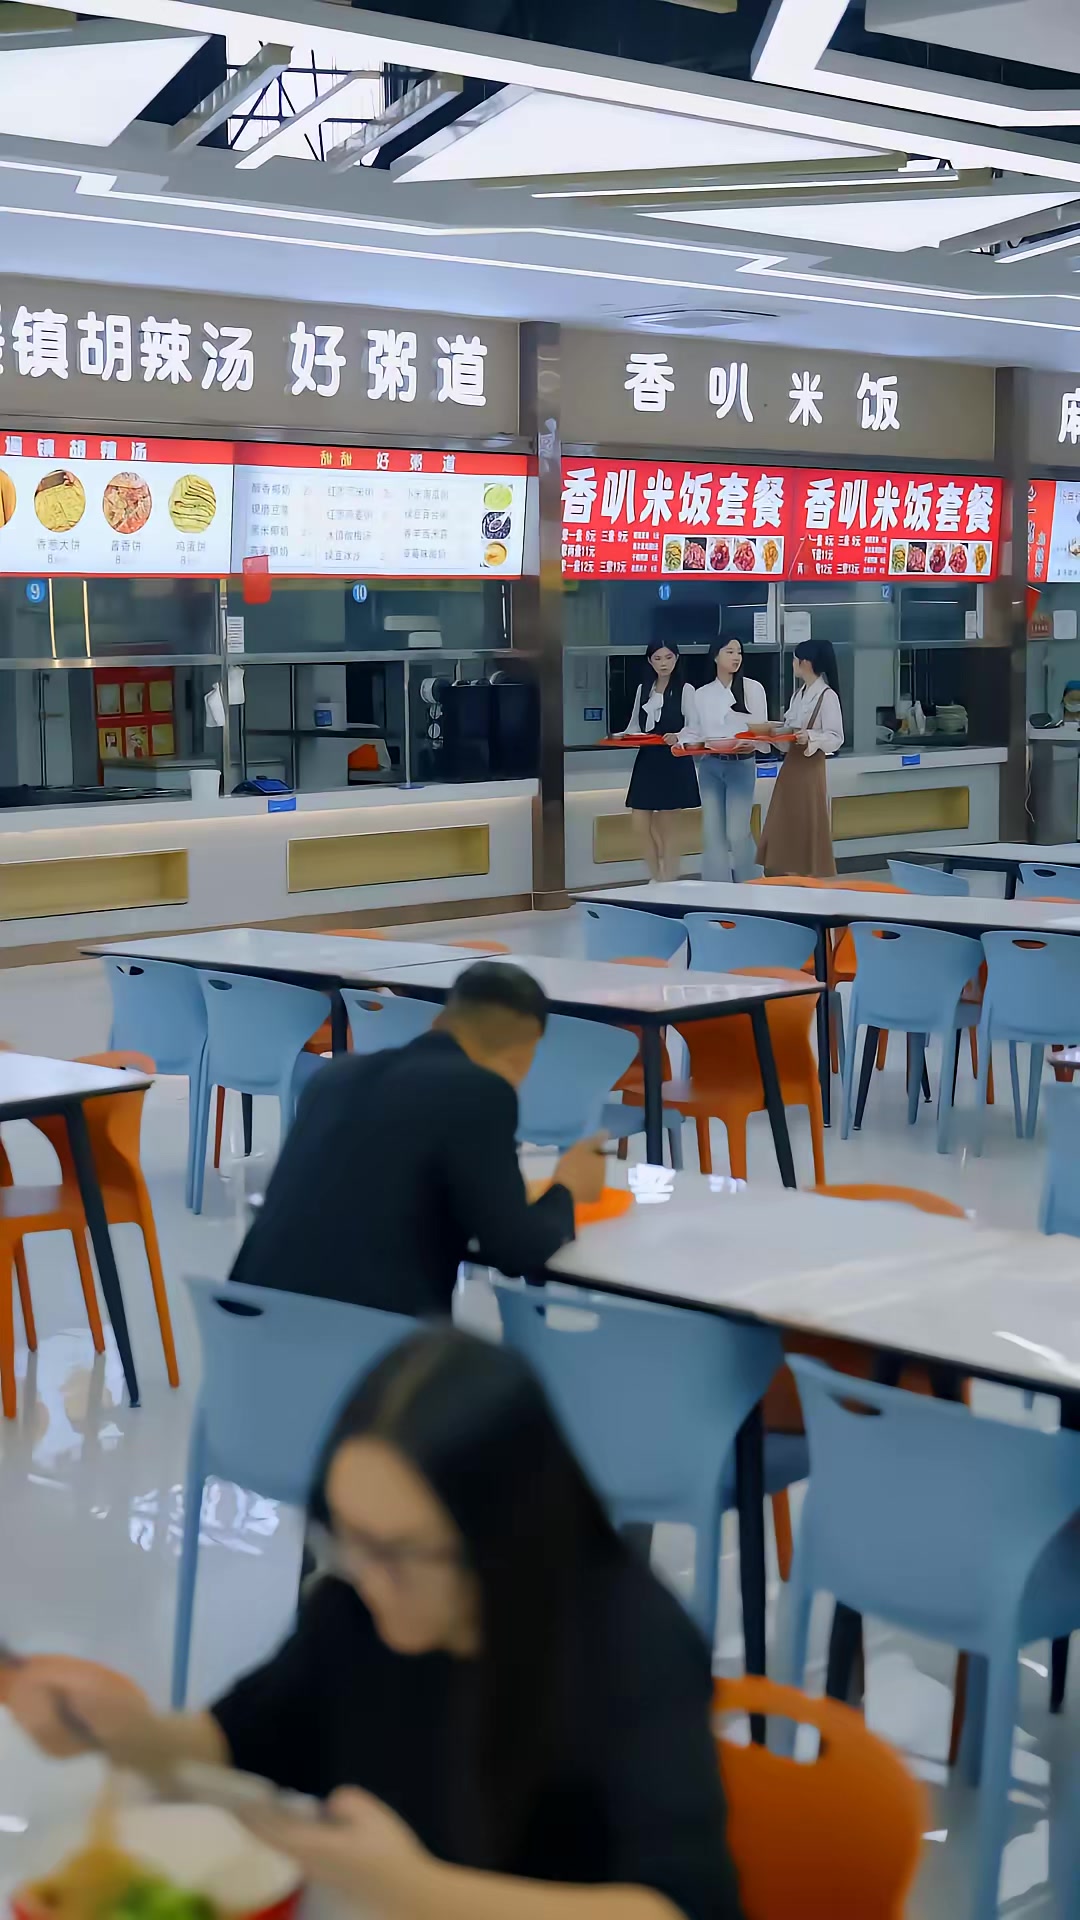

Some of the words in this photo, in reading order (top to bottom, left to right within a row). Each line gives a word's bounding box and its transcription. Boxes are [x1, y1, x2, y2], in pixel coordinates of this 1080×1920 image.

[0, 304, 254, 392] 镇胡辣汤
[290, 321, 488, 407] 好粥道
[624, 353, 900, 431] 香叭米饭
[561, 467, 785, 528] 香叭米饭套餐
[804, 478, 994, 534] 香叭米饭套餐
[354, 584, 367, 600] 10
[659, 585, 670, 599] 11
